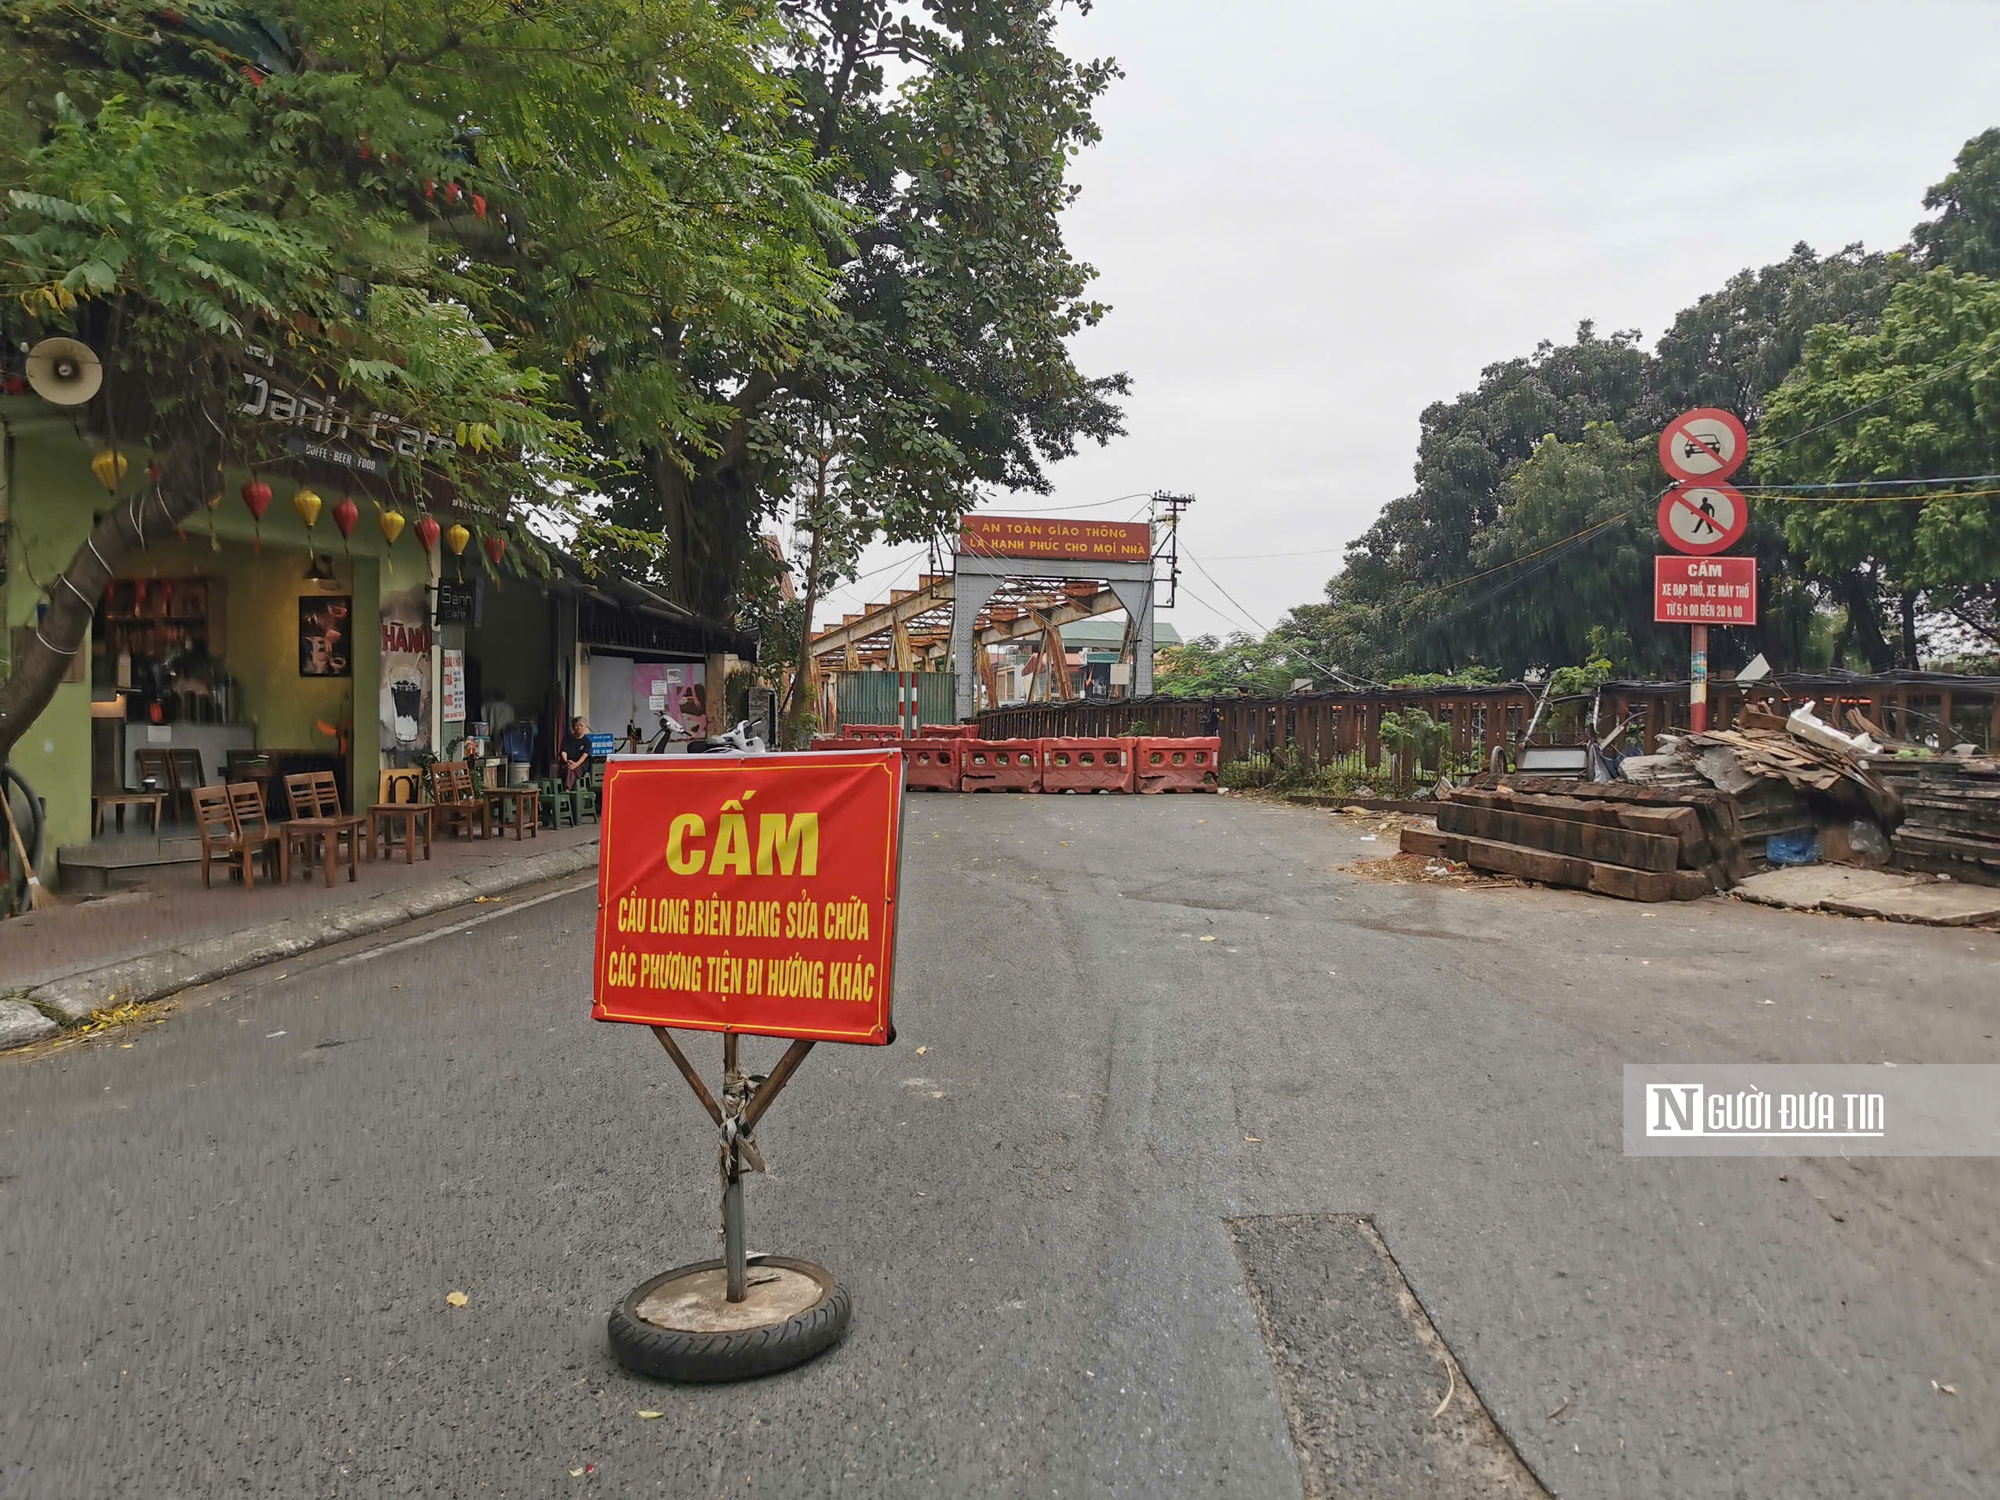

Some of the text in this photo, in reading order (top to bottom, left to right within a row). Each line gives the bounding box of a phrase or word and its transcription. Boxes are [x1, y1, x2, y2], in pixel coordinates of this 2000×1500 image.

[333, 450, 352, 466] BEER
[357, 457, 376, 471] FOOD
[982, 523, 1000, 533] AN
[1007, 521, 1042, 535] TOÀN
[1086, 525, 1127, 538] THÔNG
[991, 539, 1025, 552] HẠNH
[1029, 537, 1060, 551] PHÚC
[1065, 542, 1088, 553] CHO
[1121, 542, 1146, 555] NHÀ
[1687, 560, 1722, 578] CẤM
[1662, 583, 1672, 596] XE
[1673, 584, 1688, 599] ĐẠP
[1706, 584, 1717, 597] XE
[1718, 582, 1734, 598] MÁY
[1666, 600, 1743, 618] TỪ 5 h 00 ĐẾN 20 h 00
[666, 790, 819, 876] CẤM
[618, 885, 869, 941] CẦU LONG BIÊN ĐANG SỬA CHỮA
[608, 945, 875, 1002] CÁC PHƯƠNG TIỆN ĐI HƯỚNG KHÁC
